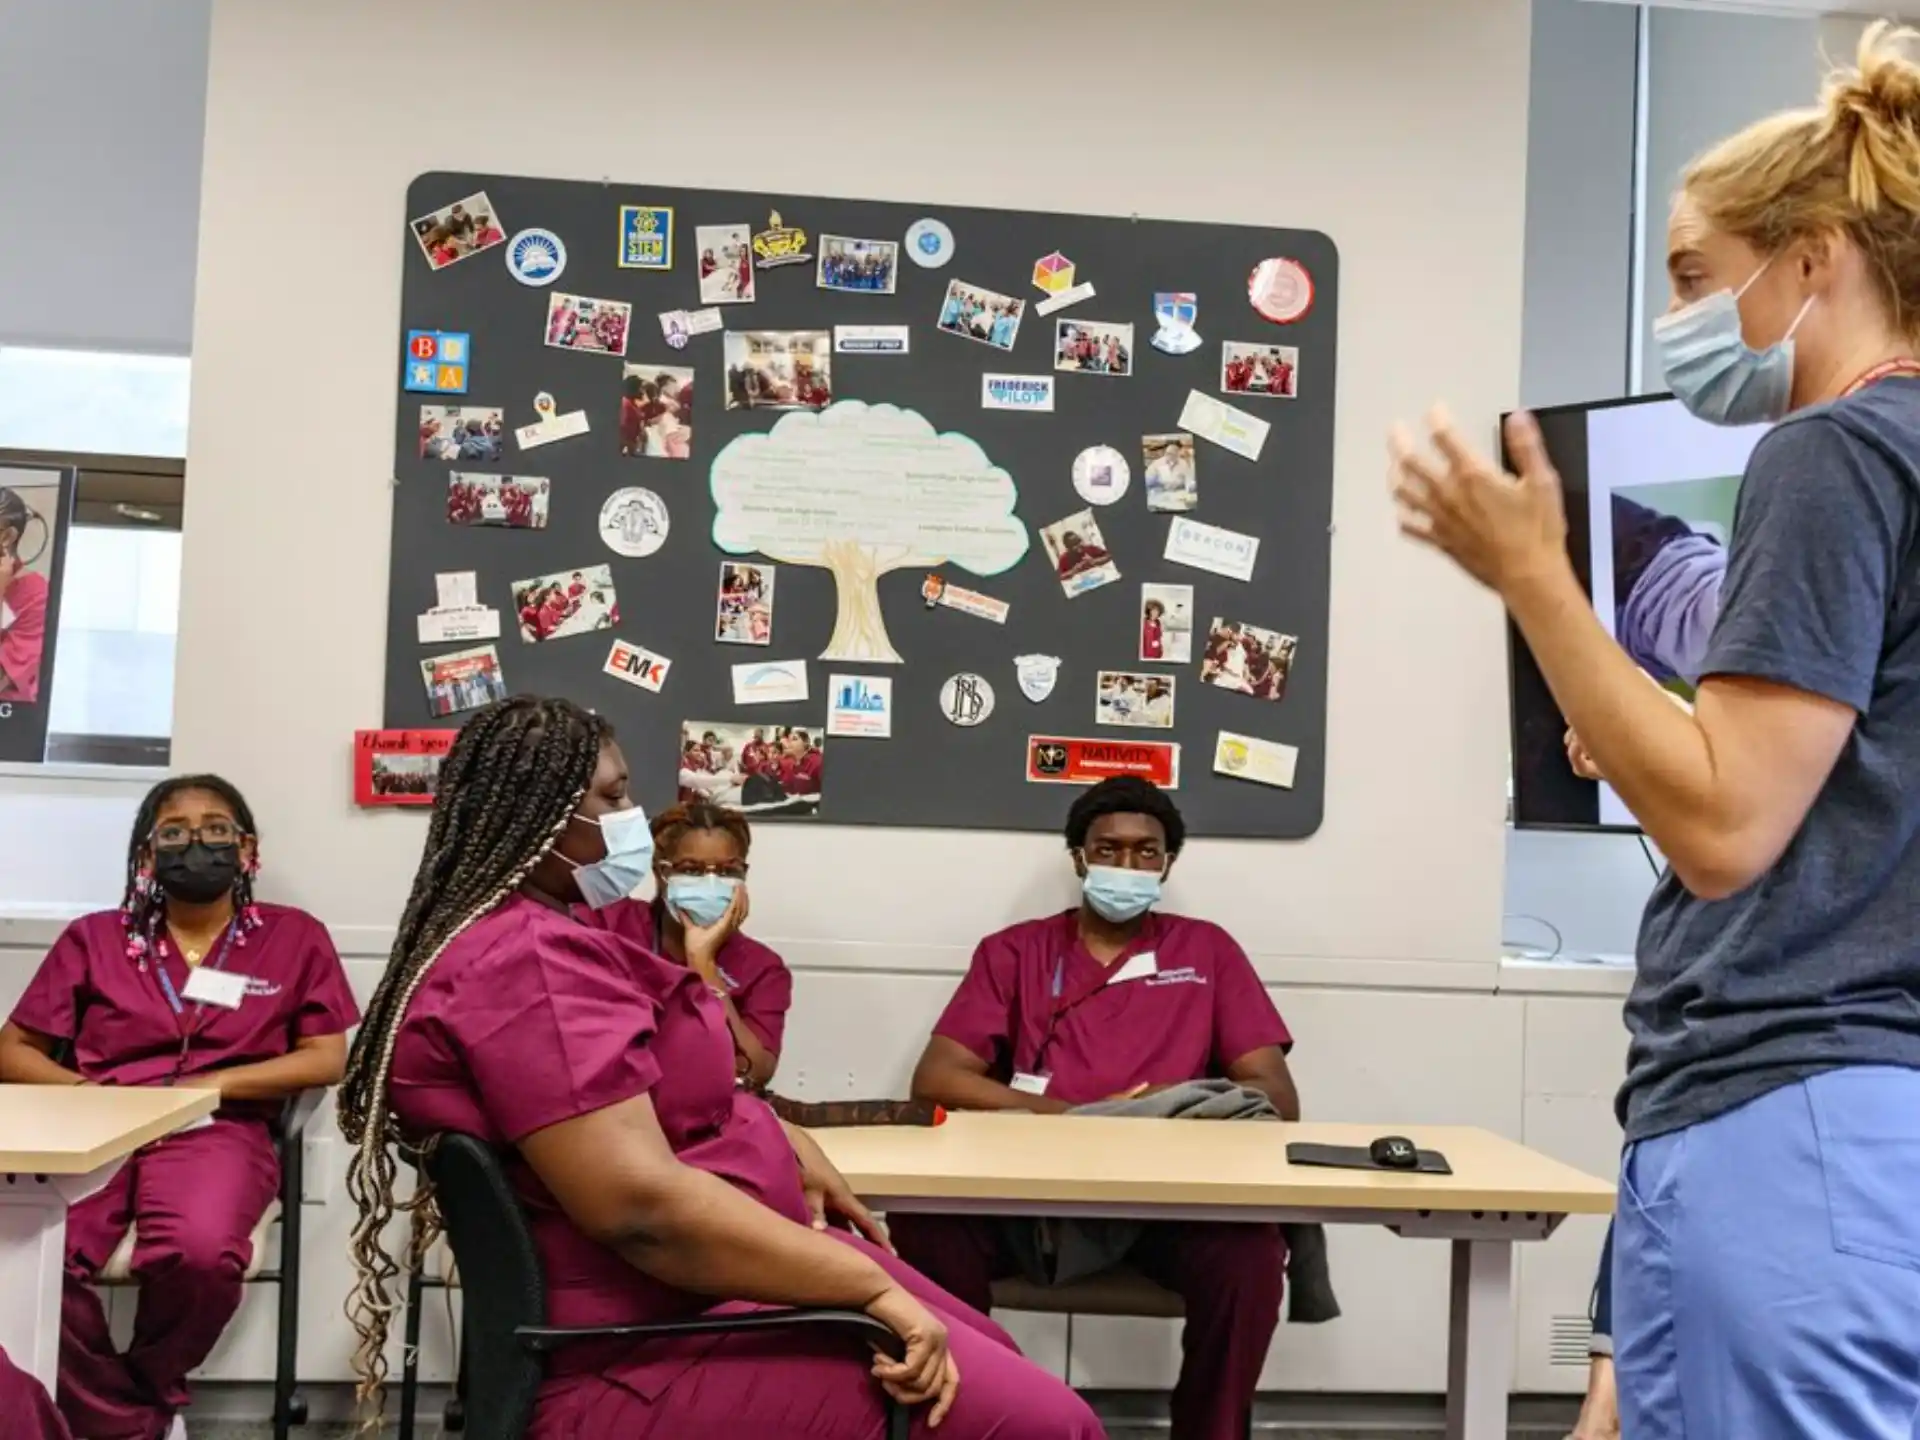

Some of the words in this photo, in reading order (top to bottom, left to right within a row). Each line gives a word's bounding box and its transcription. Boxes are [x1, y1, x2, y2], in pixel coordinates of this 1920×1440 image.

[418, 337, 433, 358] B
[441, 368, 458, 388] A
[988, 379, 1049, 391] FREDERICK
[1000, 390, 1040, 405] PILOT
[1182, 529, 1245, 553] BEACON
[610, 648, 664, 684] EMK
[420, 738, 449, 753] you
[1080, 744, 1155, 761] NATIVITY
